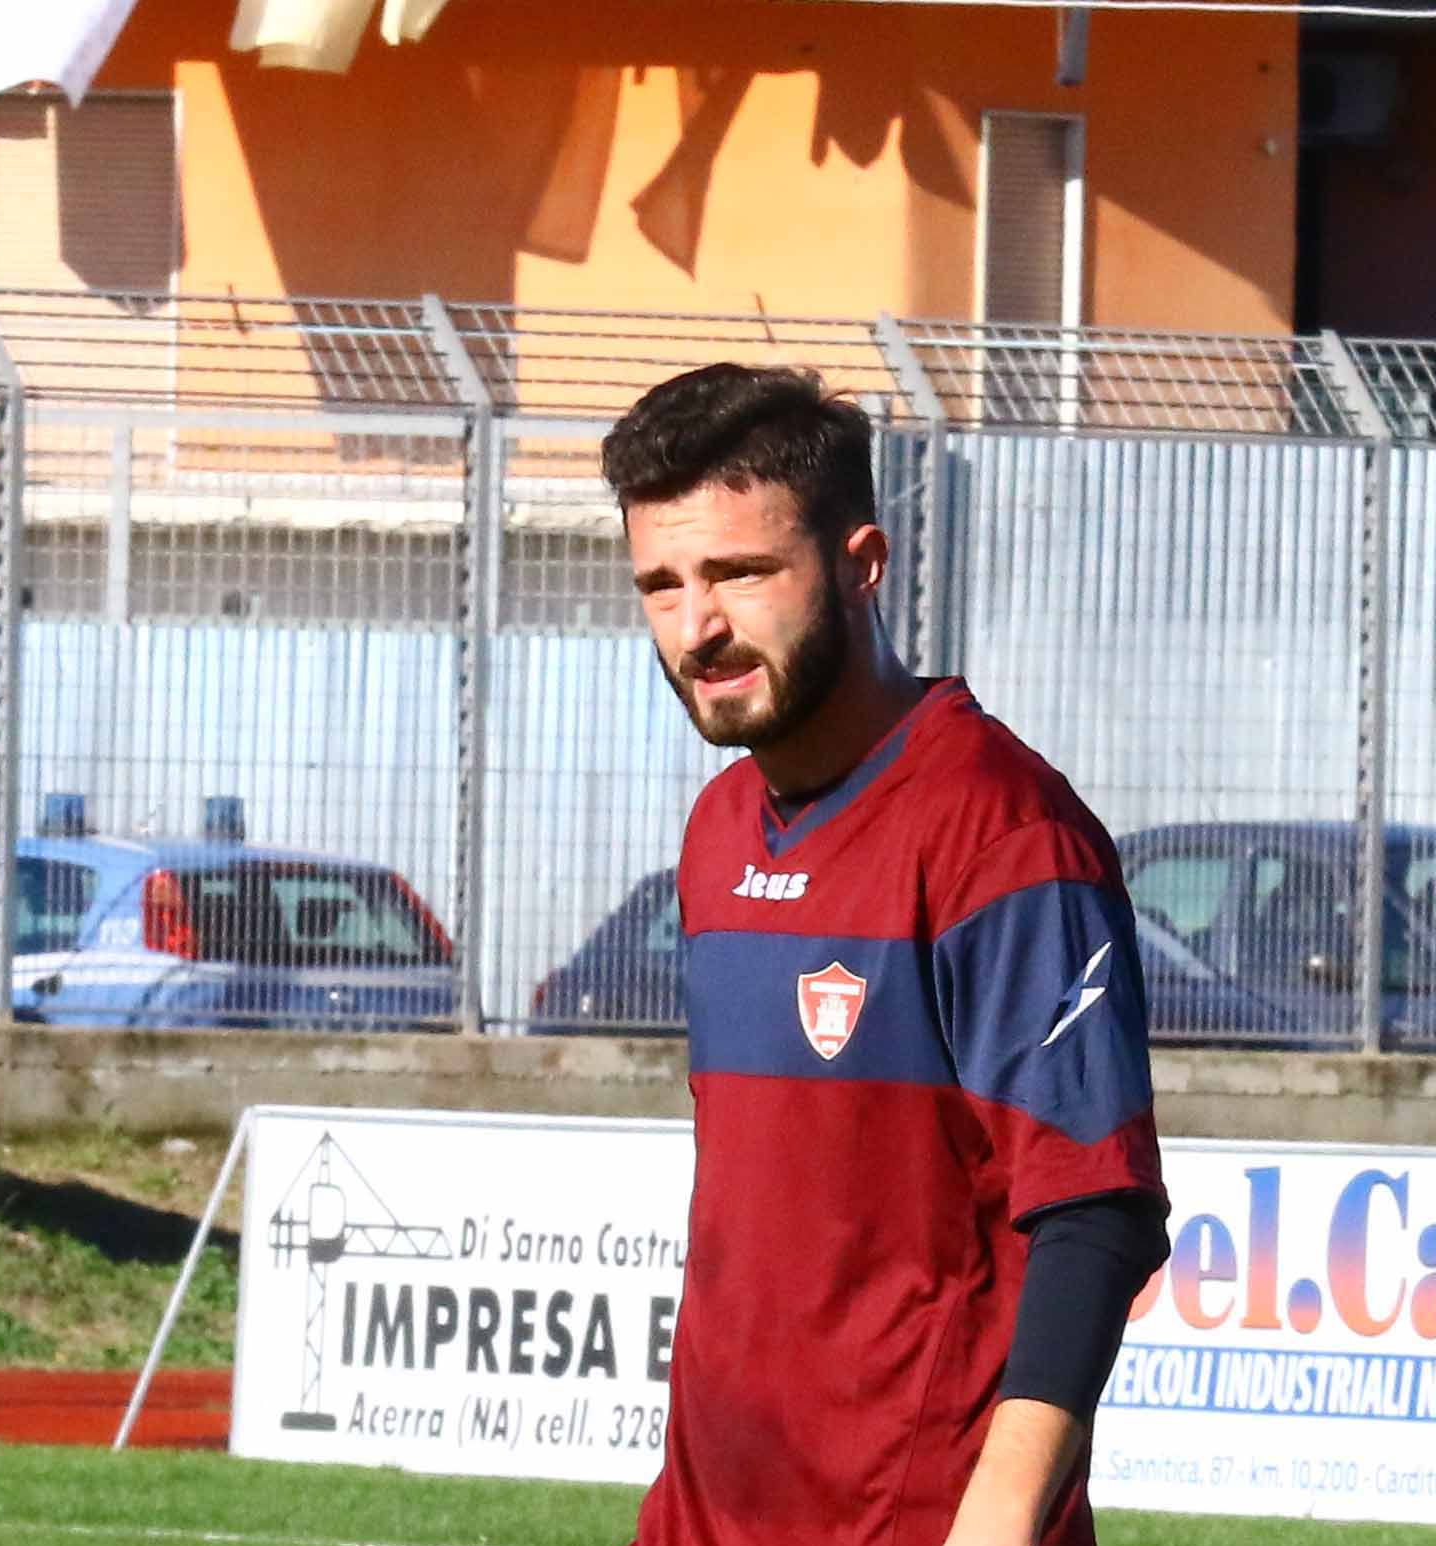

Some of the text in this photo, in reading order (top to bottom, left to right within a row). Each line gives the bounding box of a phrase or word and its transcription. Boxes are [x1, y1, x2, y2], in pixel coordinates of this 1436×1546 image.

[459, 1216, 490, 1259] Di
[500, 1218, 583, 1265] Sarno
[341, 1281, 618, 1380] IMPRESA
[1214, 1351, 1416, 1419] INDUSTRIALI
[347, 1391, 664, 1450] Acerra (NA) cell. 328
